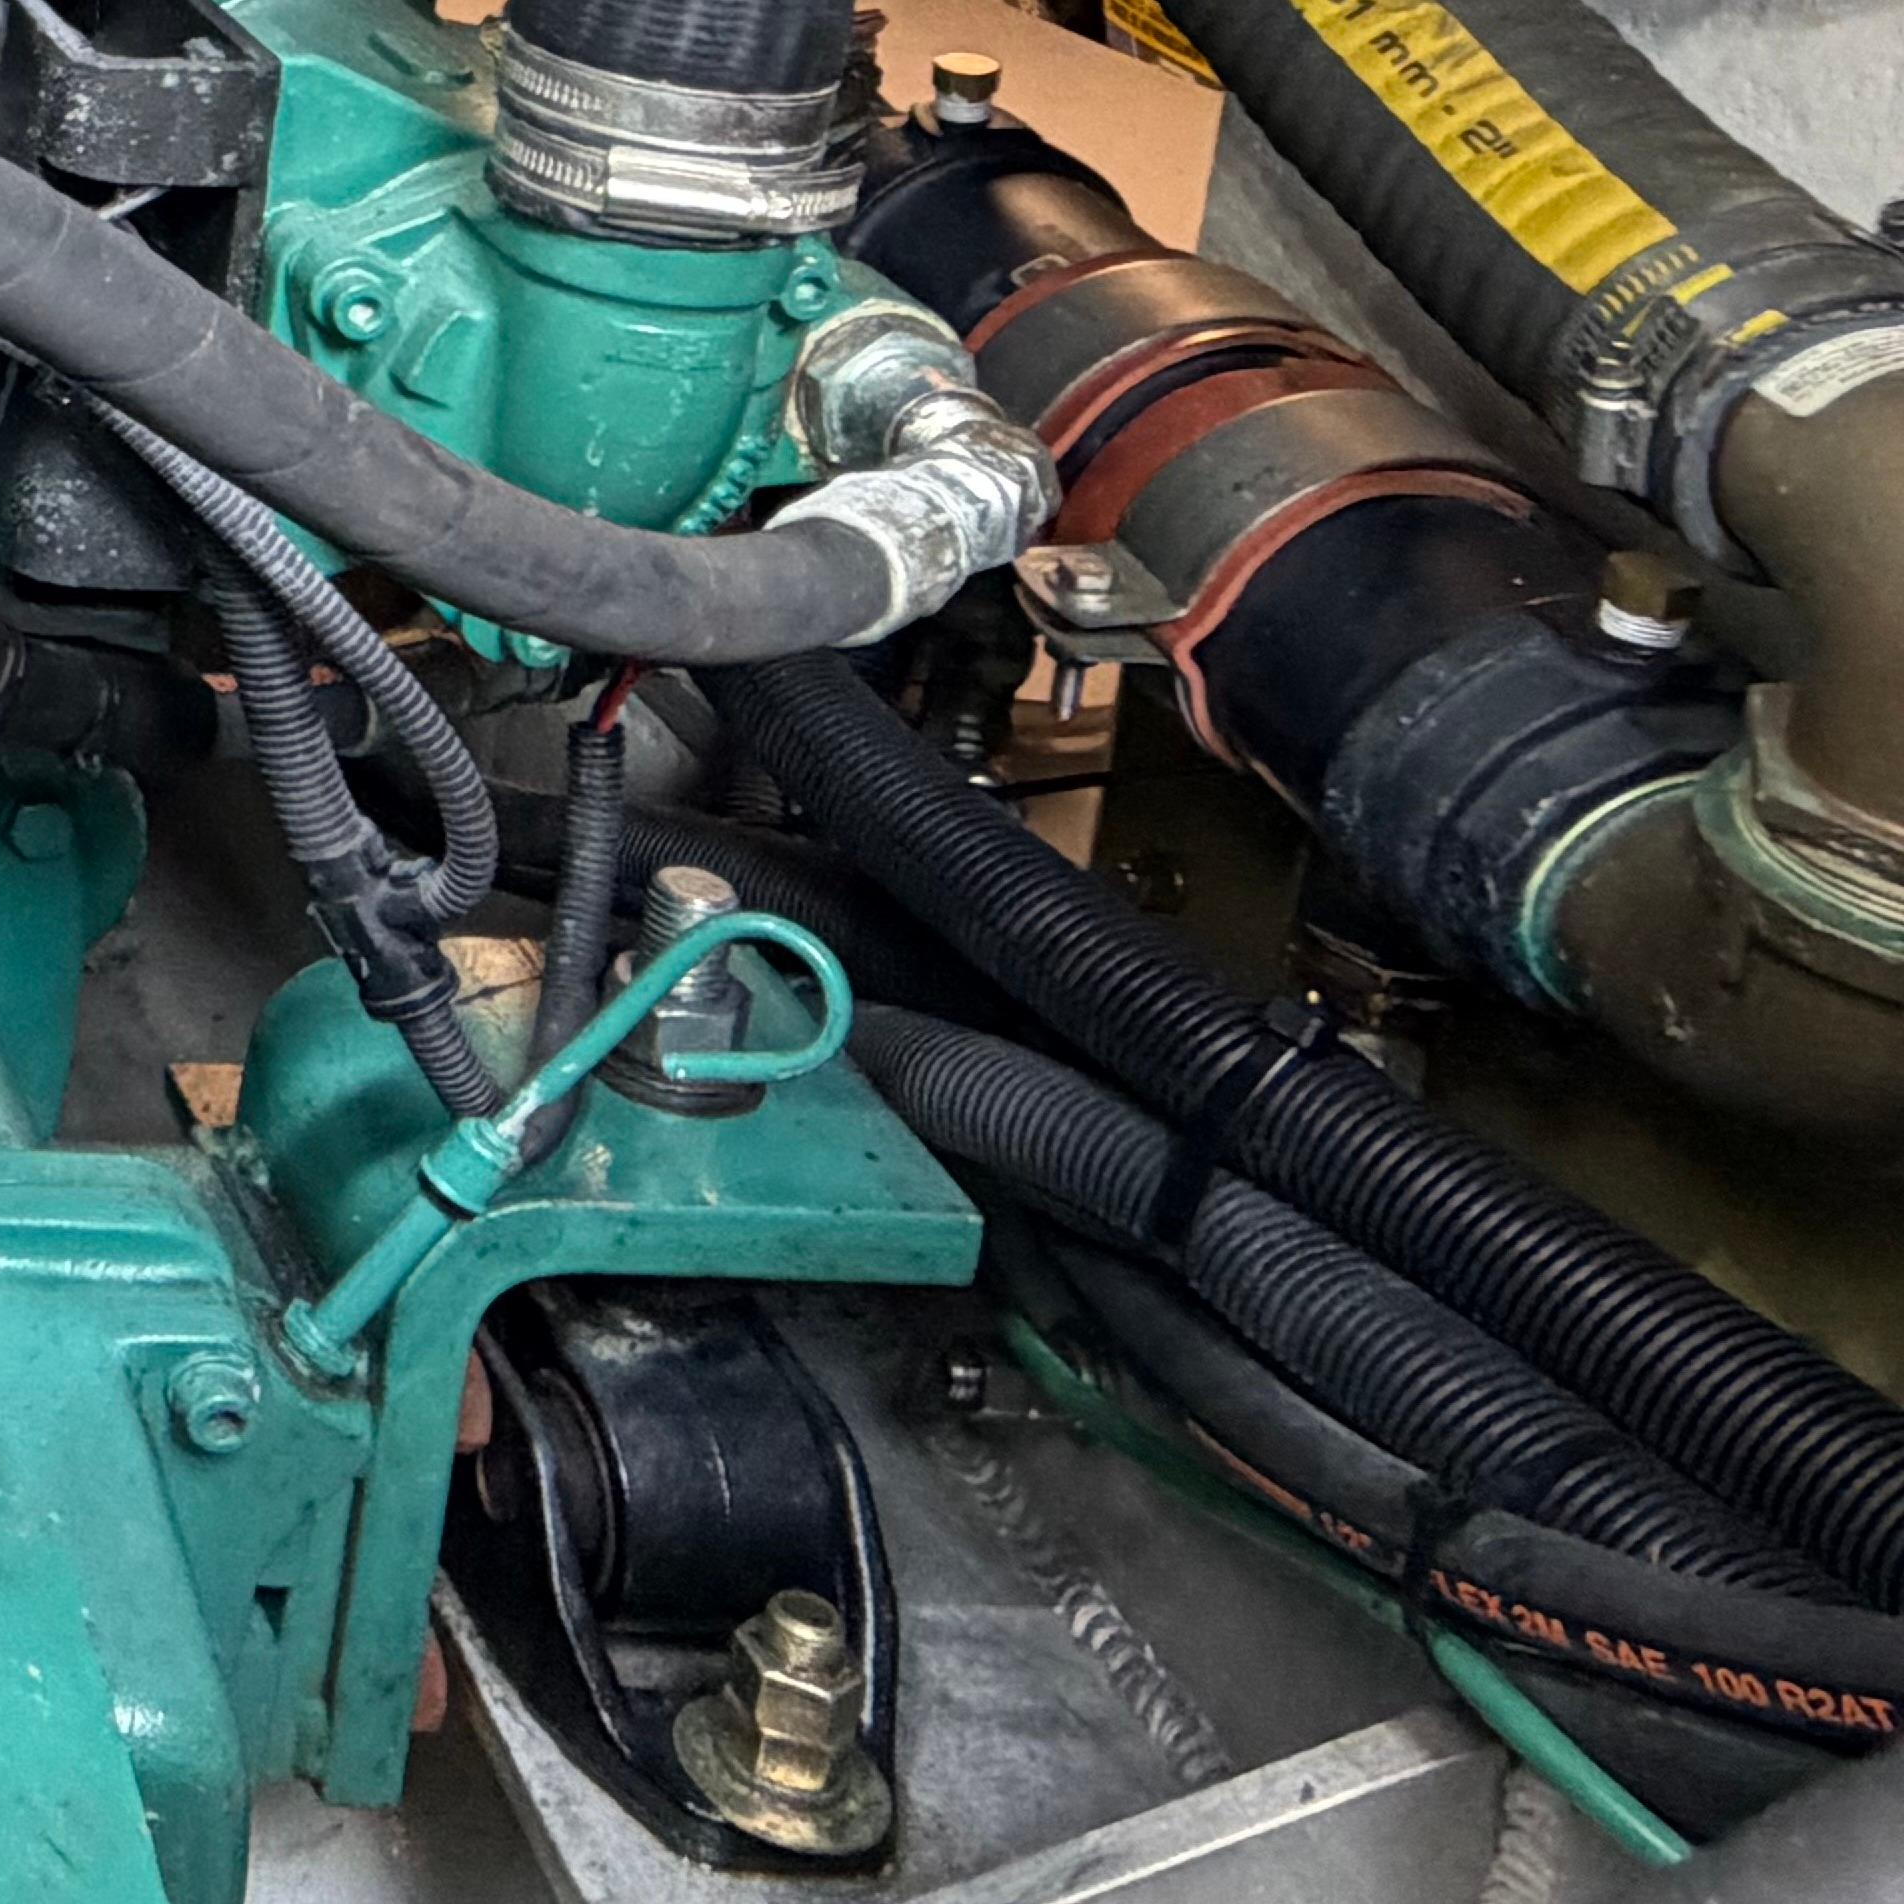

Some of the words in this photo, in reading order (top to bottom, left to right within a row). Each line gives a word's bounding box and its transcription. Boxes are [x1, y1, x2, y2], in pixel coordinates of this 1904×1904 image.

[1368, 29, 1442, 102] mm
[1583, 1630, 1674, 1682] SAE
[1691, 1662, 1771, 1708] 100
[1774, 1679, 1895, 1733] R2AT
